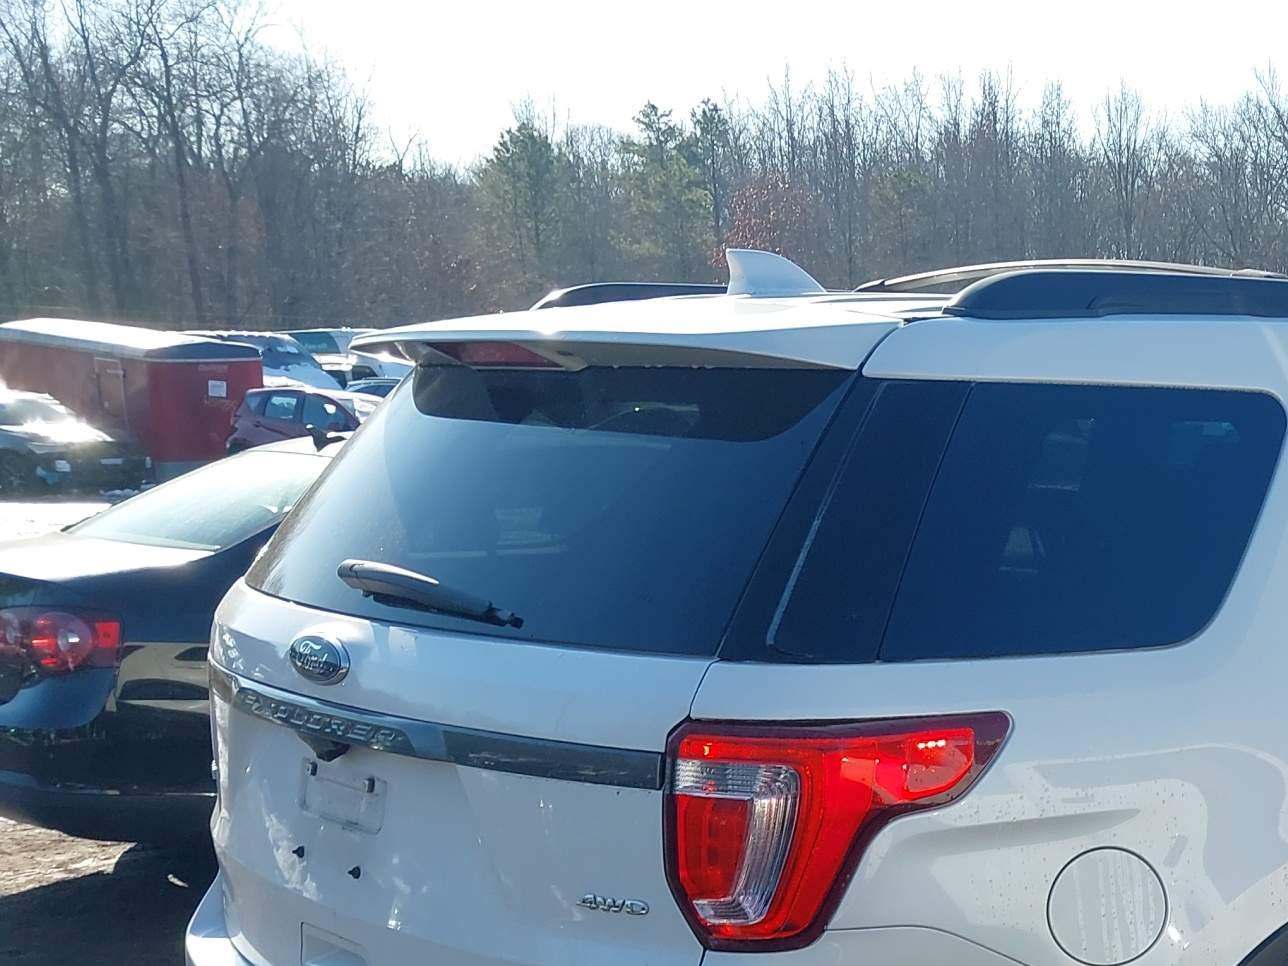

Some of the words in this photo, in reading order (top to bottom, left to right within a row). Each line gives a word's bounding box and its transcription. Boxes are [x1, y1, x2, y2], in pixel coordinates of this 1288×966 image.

[295, 641, 334, 674] Ford
[240, 692, 404, 748] EXPLORER
[576, 893, 650, 915] 4WD
